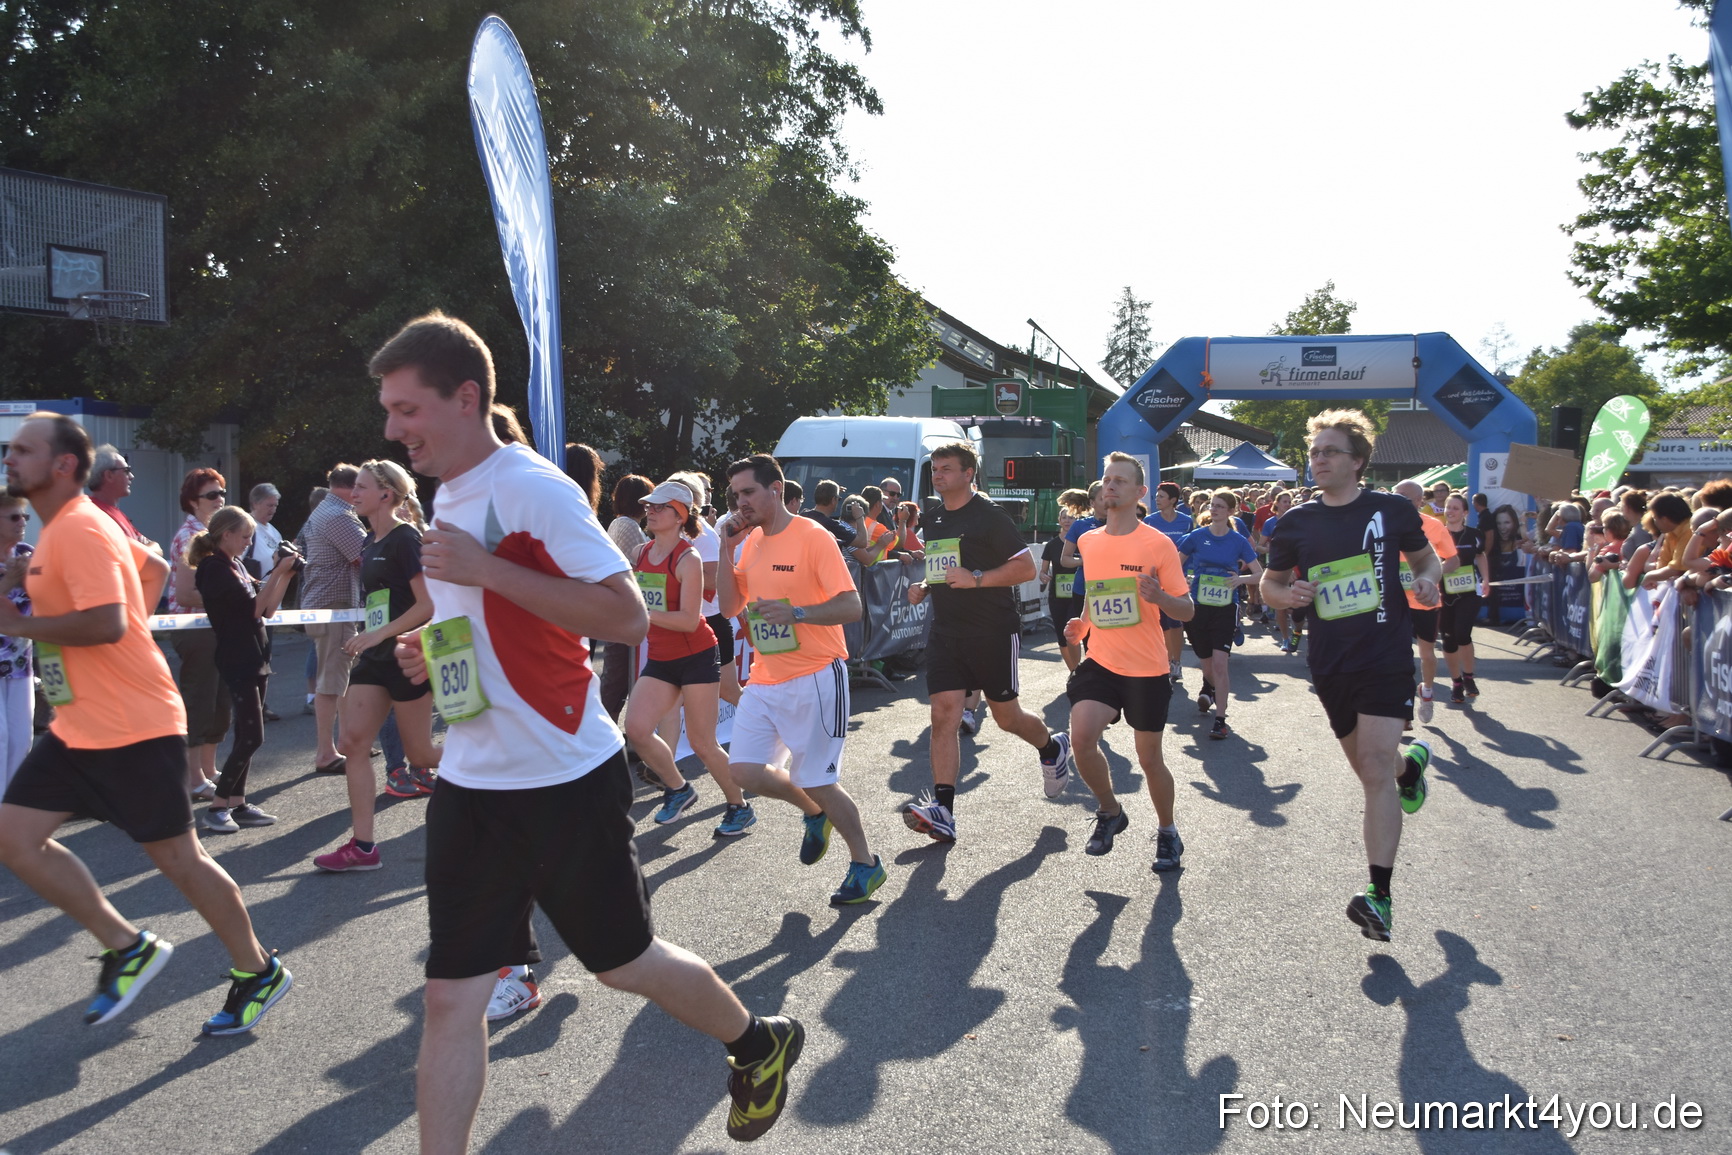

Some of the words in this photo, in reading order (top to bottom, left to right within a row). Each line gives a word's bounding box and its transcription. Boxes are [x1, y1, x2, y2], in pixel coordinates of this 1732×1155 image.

[1308, 351, 1335, 360] Fischer
[1288, 366, 1367, 380] firmenlauf
[1144, 394, 1185, 404] Fischer
[1613, 430, 1638, 456] AOK
[1654, 443, 1685, 453] Jura
[1586, 449, 1615, 478] AOK
[928, 556, 957, 571] 1196
[1121, 564, 1142, 572] THULE
[1448, 576, 1472, 586] 1085
[1202, 587, 1228, 599] 1441
[1320, 578, 1372, 604] 1144
[1093, 597, 1132, 616] 1451
[368, 610, 383, 627] 109
[753, 623, 791, 641] 1542
[441, 659, 468, 696] 830
